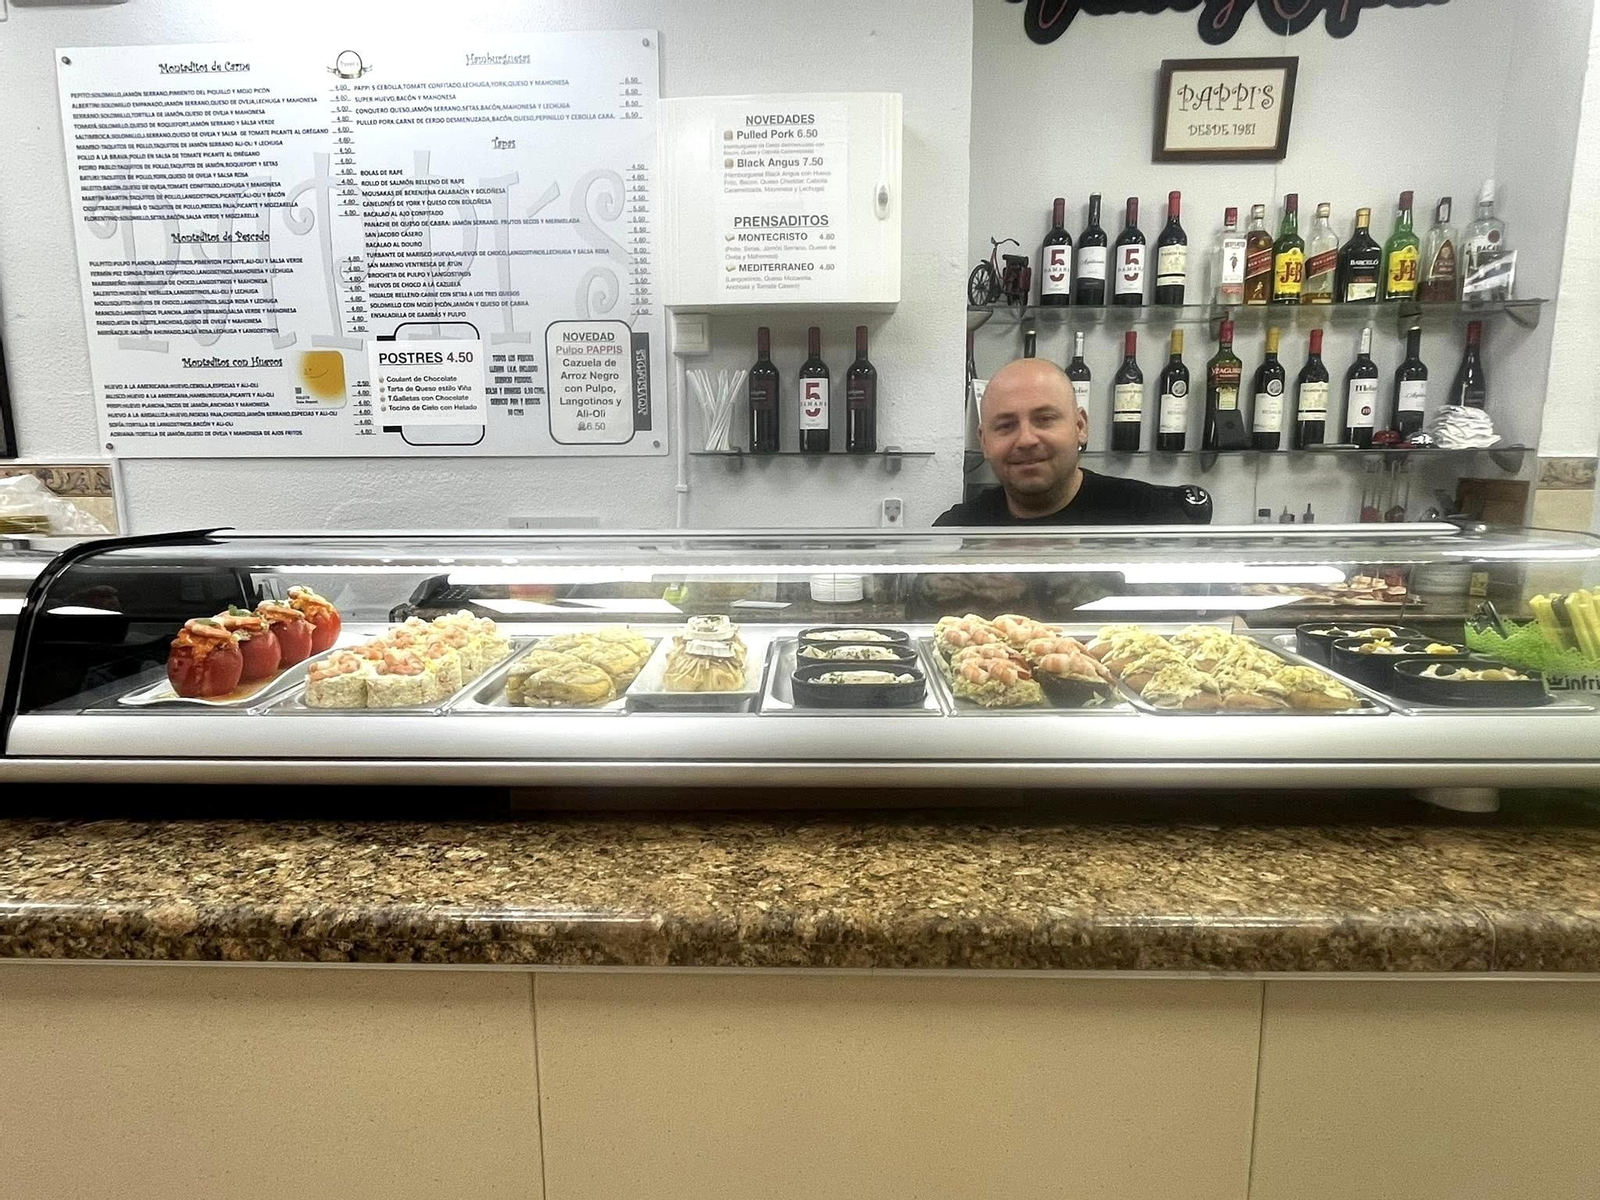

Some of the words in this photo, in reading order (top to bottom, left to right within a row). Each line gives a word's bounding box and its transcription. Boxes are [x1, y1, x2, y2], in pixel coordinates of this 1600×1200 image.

[158, 61, 208, 73] Montaditos
[211, 60, 221, 72] de
[224, 61, 250, 72] Carne
[1177, 83, 1274, 111] PAPPI'S
[746, 114, 815, 125] NOVEDADES
[737, 130, 767, 140] Pulled
[771, 130, 794, 138] Pork
[797, 129, 818, 138] 6.50
[1188, 124, 1229, 136] DESDE
[1233, 123, 1256, 135] 1981
[737, 159, 765, 167] Black
[768, 158, 800, 168] Angus
[803, 157, 823, 166] 7.50
[734, 215, 829, 227] PRENSADITOS
[171, 229, 220, 242] Montaditos
[223, 232, 232, 241] de
[235, 230, 270, 241] Pescado
[738, 233, 808, 241] MONTECRISTO
[739, 263, 814, 272] MEDITERRANEO
[1050, 249, 1065, 282] 5
[1124, 249, 1139, 281] 5
[1393, 260, 1416, 281] J&B
[1280, 262, 1302, 283] J&B
[562, 332, 615, 342] NOVEDAD
[556, 346, 584, 355] Pulpo
[181, 357, 230, 368] Montaditos
[251, 356, 283, 367] Huevos
[379, 352, 443, 364] POSTRES
[447, 352, 473, 363] 4.50
[562, 359, 601, 367] Cazuela
[590, 372, 619, 381] Negro
[586, 384, 616, 394] Pulpo,
[560, 397, 613, 407] Langotinos
[806, 382, 821, 417] 5
